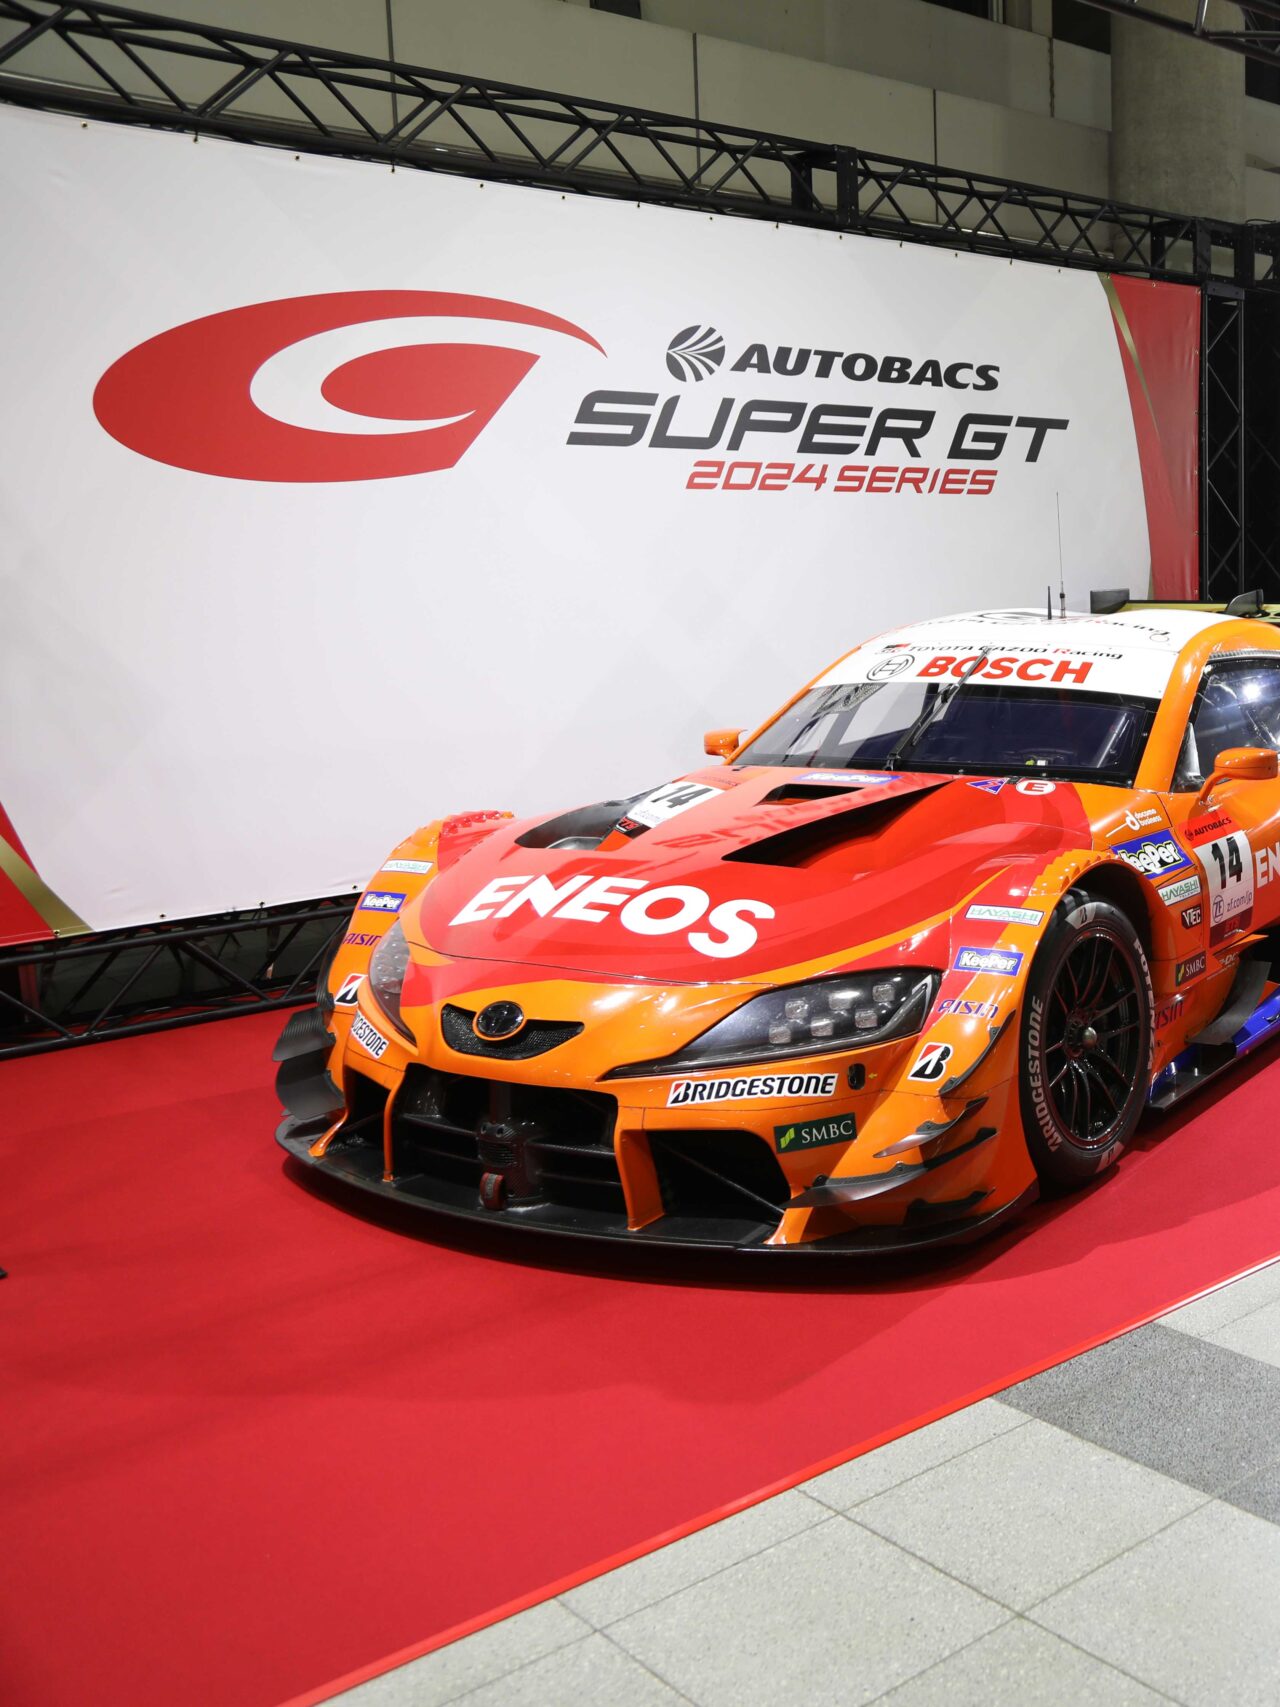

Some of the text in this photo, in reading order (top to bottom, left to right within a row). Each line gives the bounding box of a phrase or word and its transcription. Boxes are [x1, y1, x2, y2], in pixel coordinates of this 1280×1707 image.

[730, 343, 1001, 391] AUTOBACS
[566, 390, 1070, 462] SUPER GT
[685, 459, 999, 495] 2024 SERIES
[1052, 647, 1124, 660] Racing
[916, 655, 1094, 684] BOSCH
[650, 784, 714, 809] 14
[1193, 817, 1232, 838] AUTOBACS
[1211, 836, 1243, 890] 14
[1161, 879, 1200, 901] HAYASHI
[448, 874, 776, 959] ENEOS
[970, 907, 1039, 922] HAYASHI
[959, 950, 1018, 972] KeePer
[1185, 955, 1205, 977] SMBC
[1028, 995, 1064, 1152] BRIDGESTONE
[669, 1074, 836, 1105] BRIDGESTONE
[801, 1119, 853, 1144] SMBC
